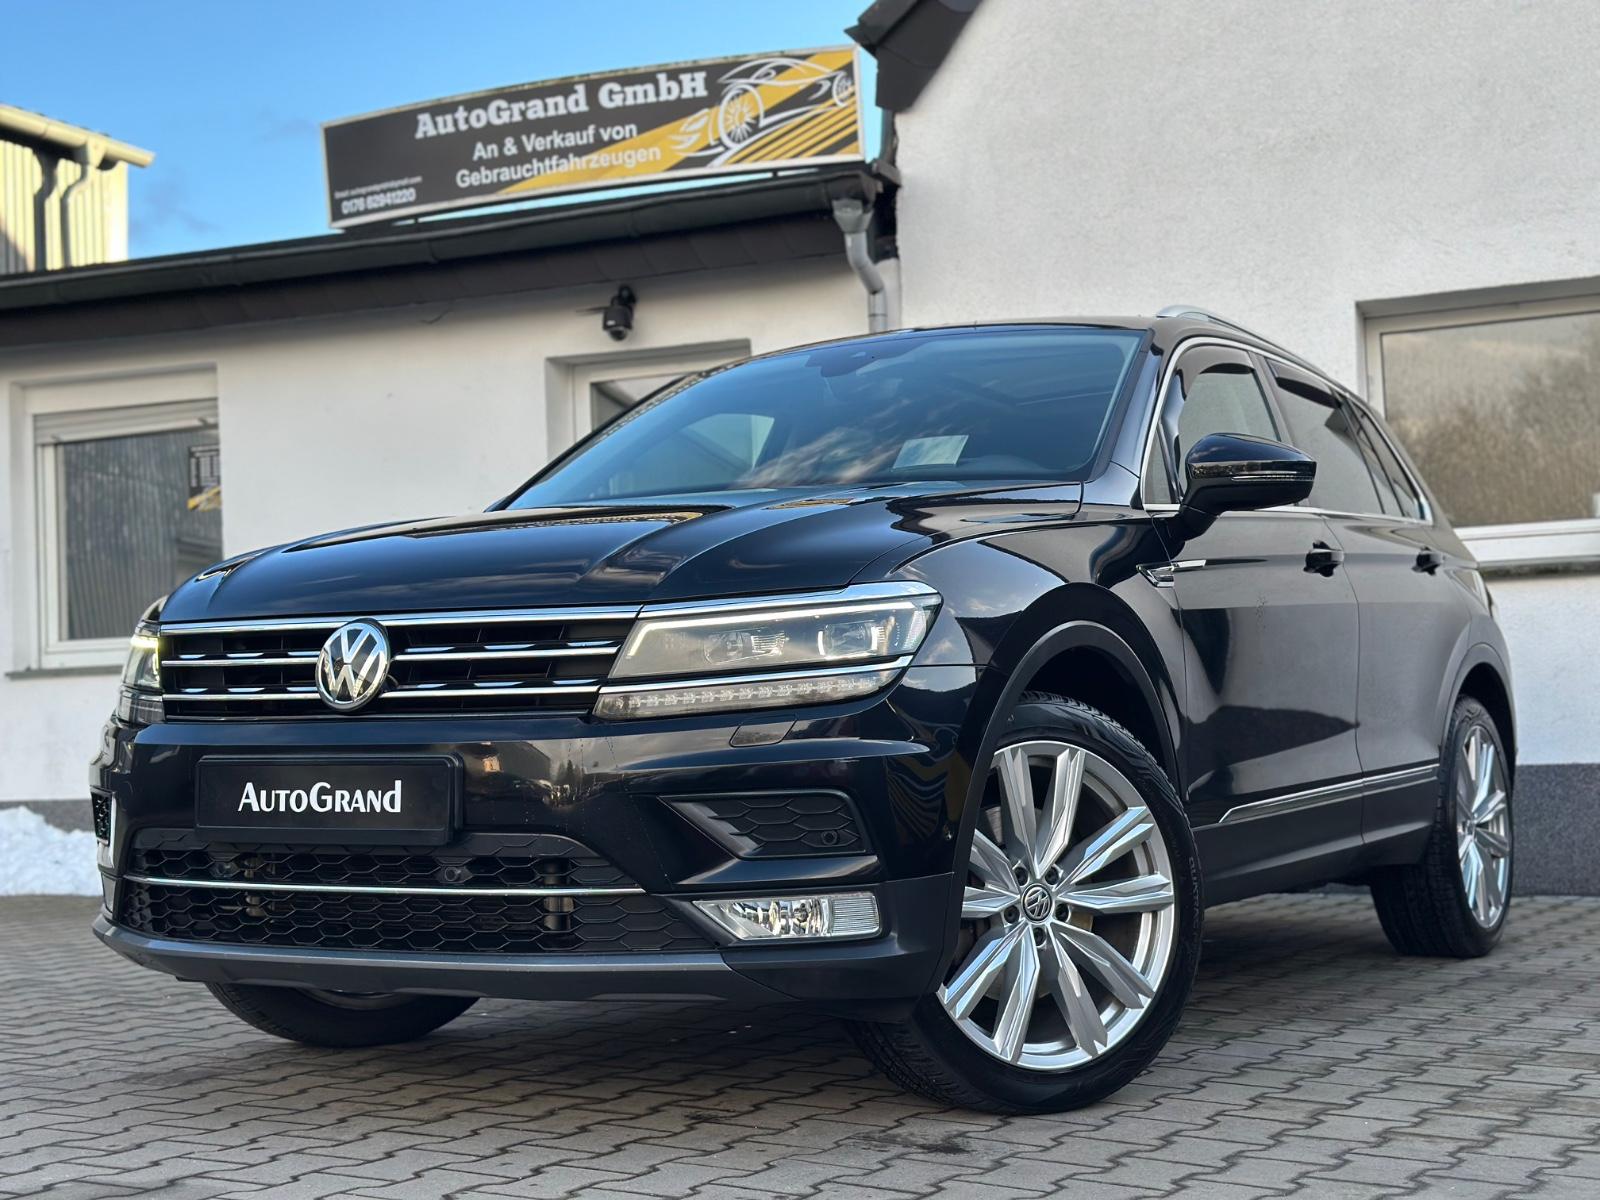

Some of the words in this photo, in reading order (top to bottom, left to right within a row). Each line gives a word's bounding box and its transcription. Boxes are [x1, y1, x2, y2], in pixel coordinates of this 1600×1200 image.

[414, 83, 588, 139] AutoGrand
[599, 72, 708, 109] GmbH
[472, 142, 498, 161] An
[503, 137, 518, 156] &
[522, 124, 595, 153] Verkauf
[600, 123, 637, 142] von
[456, 145, 661, 188] Gebrauchtfahrzeugen
